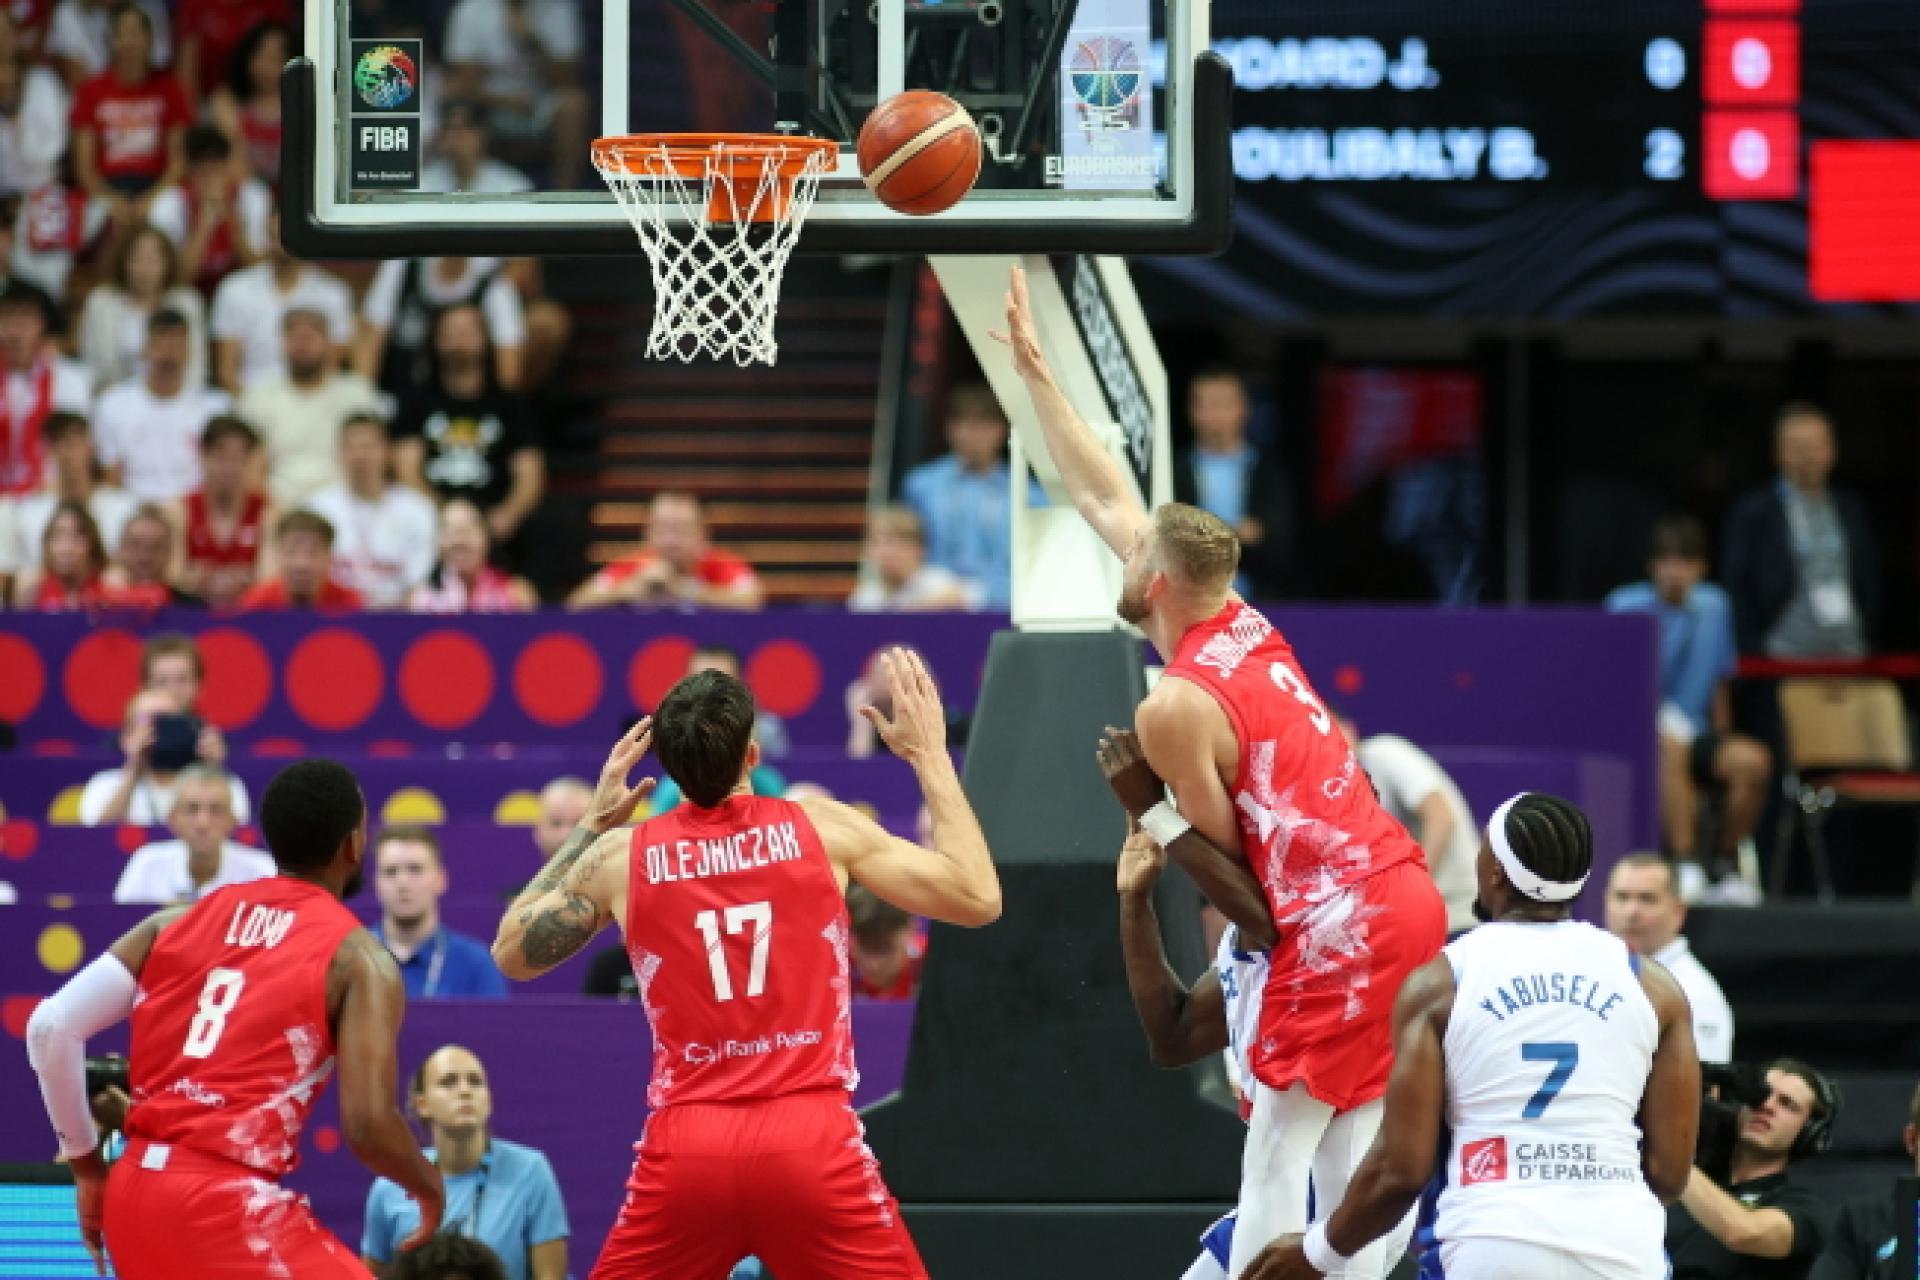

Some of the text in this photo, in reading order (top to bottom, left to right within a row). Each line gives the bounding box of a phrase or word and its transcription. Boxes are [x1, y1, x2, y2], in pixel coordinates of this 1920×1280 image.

[360, 126, 409, 151] FIBA
[1232, 127, 1486, 180] OULIBALY
[1643, 127, 1685, 180] 2
[1729, 128, 1771, 179] 0
[1269, 660, 1331, 737] 3
[645, 821, 801, 885] OLEJNICZAK
[693, 900, 772, 1003] 17
[182, 966, 246, 1058] 8
[1480, 972, 1624, 1021] YABUSELE
[1521, 1042, 1579, 1120] 7
[1515, 1143, 1598, 1162] CAISSE
